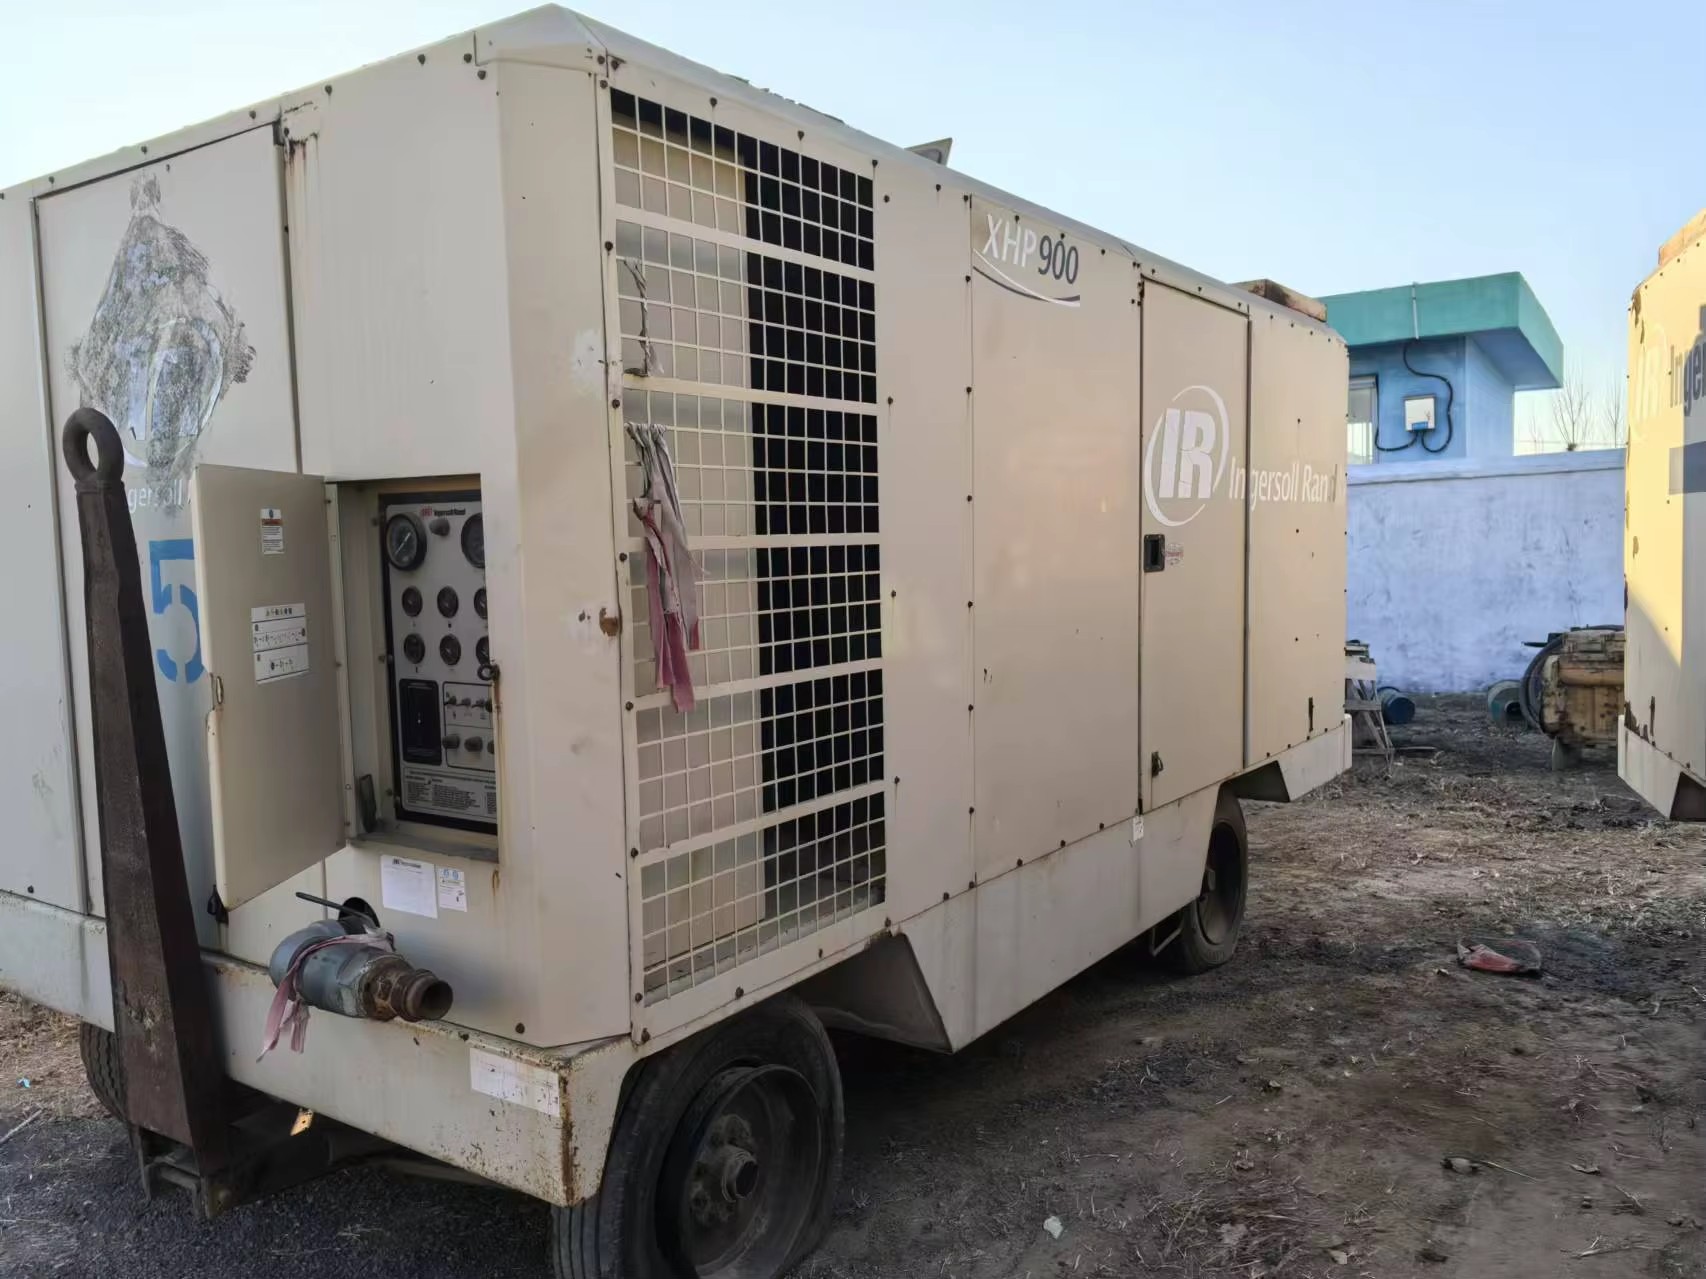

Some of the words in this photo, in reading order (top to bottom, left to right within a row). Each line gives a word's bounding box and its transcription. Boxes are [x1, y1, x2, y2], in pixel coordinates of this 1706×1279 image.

[982, 213, 1038, 268] XHP
[1037, 234, 1079, 285] 900
[1158, 407, 1216, 499] IR
[1228, 455, 1300, 512] Ingersoll
[148, 538, 205, 684] 5
